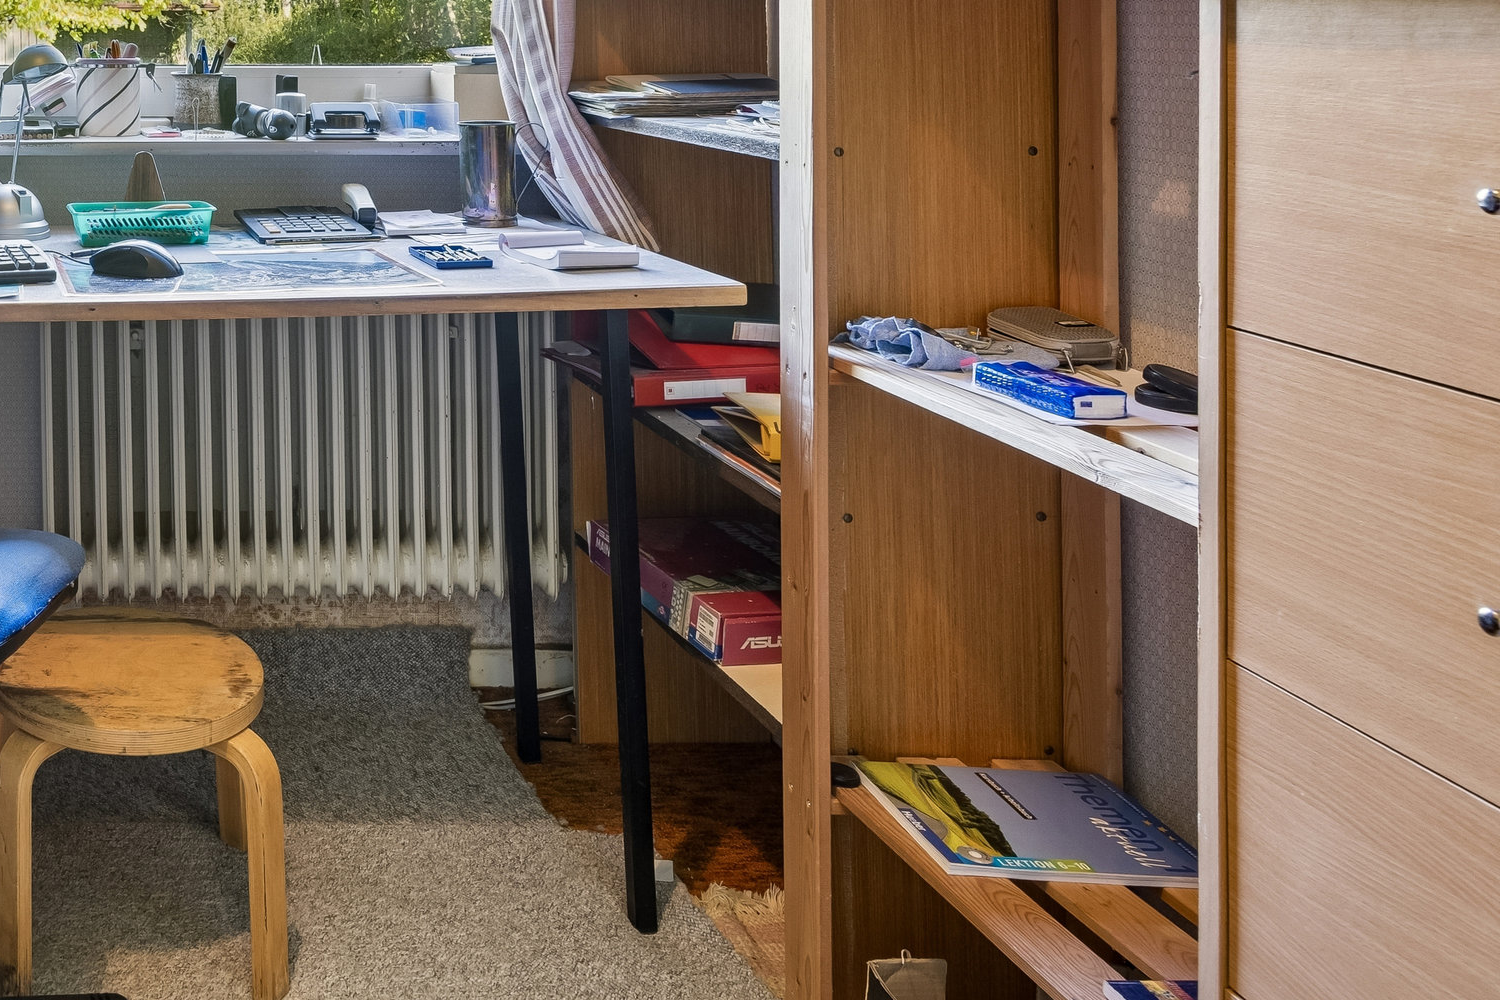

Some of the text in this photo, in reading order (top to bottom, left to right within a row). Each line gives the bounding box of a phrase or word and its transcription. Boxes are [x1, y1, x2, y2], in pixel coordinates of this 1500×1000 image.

[1054, 774, 1164, 852] Themen
[999, 858, 1057, 870] LEKTION
[1089, 817, 1172, 868] aktuell
